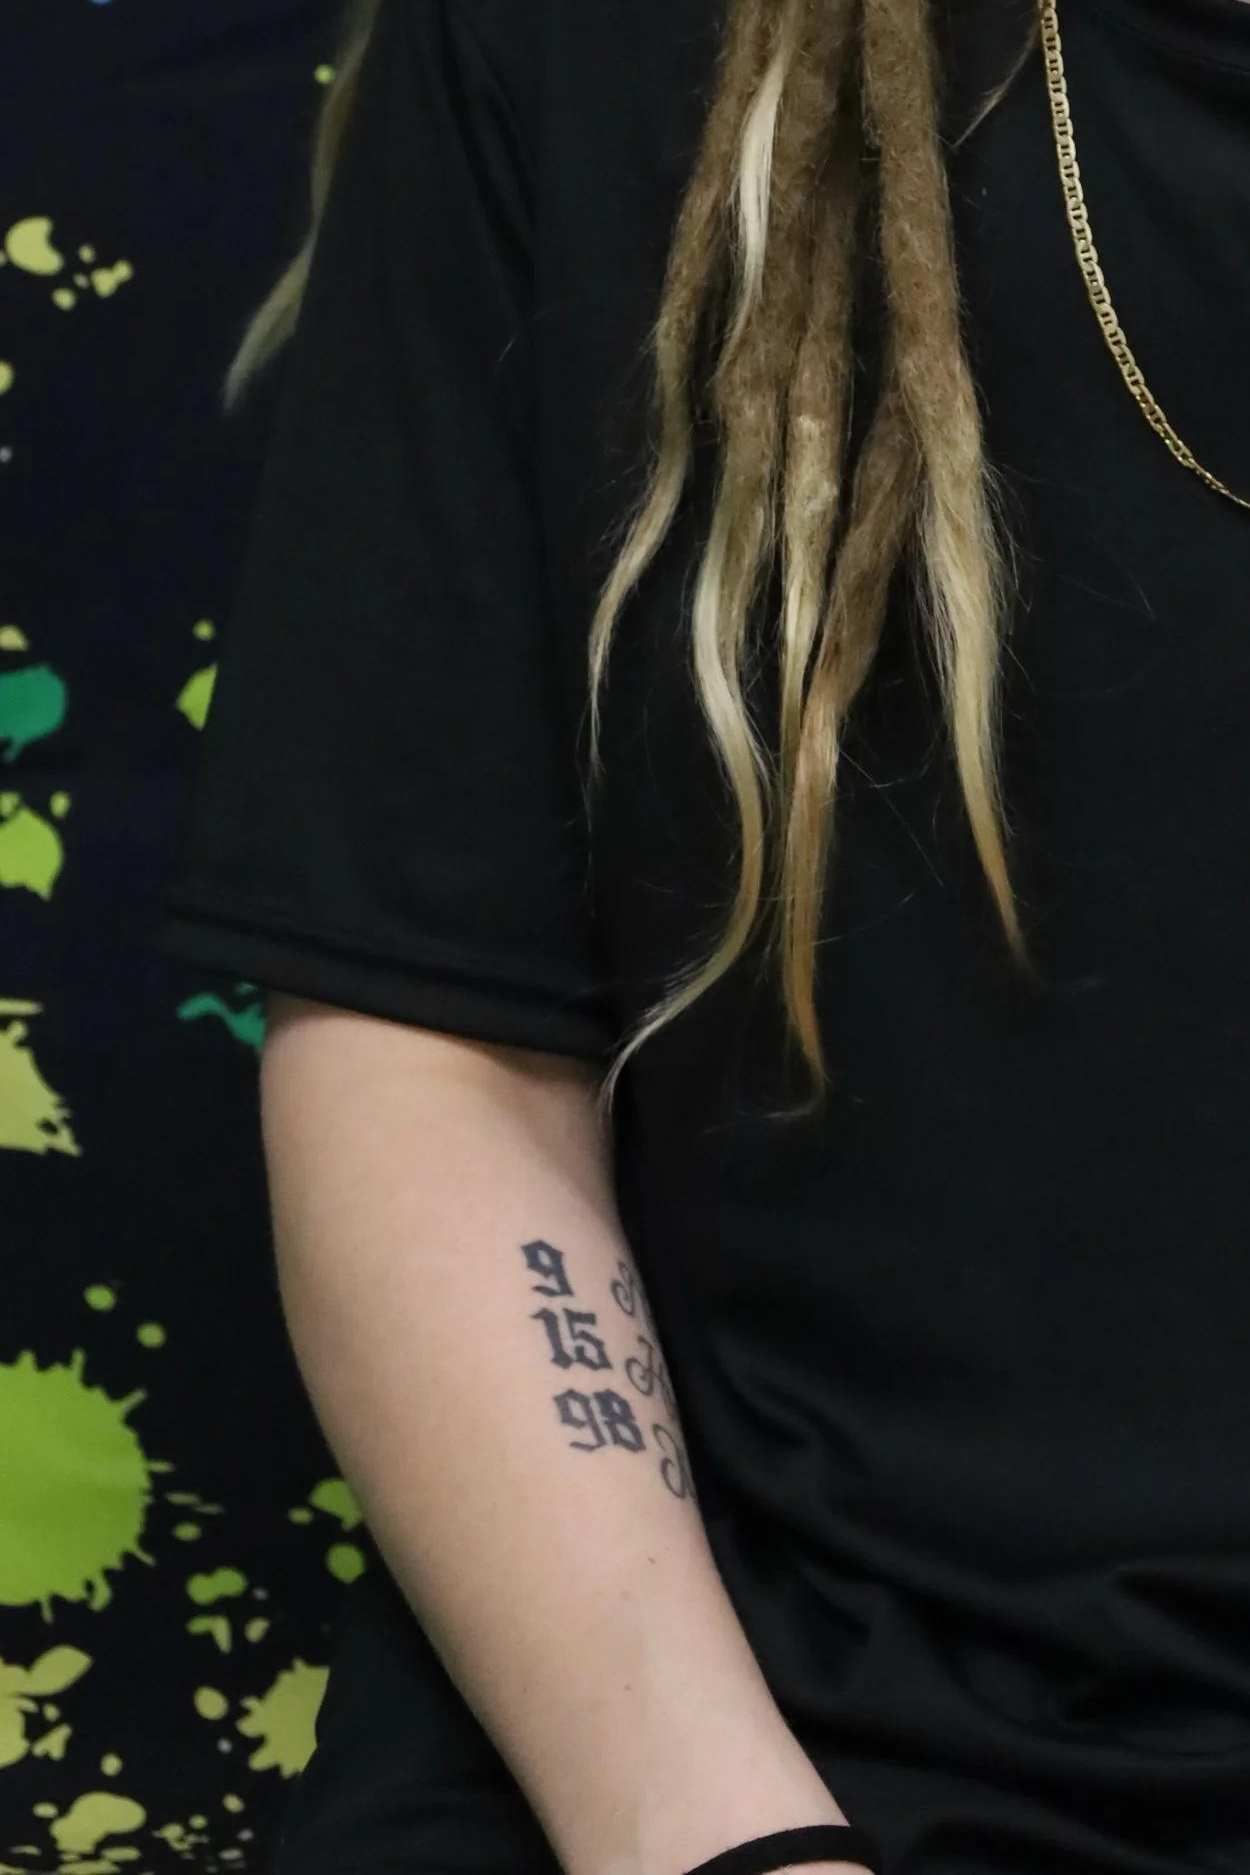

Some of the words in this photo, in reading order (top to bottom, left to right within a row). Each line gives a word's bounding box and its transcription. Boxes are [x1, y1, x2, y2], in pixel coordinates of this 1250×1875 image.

[521, 1239, 574, 1297] 9
[531, 1307, 613, 1371] 15
[552, 1388, 646, 1453] 98
